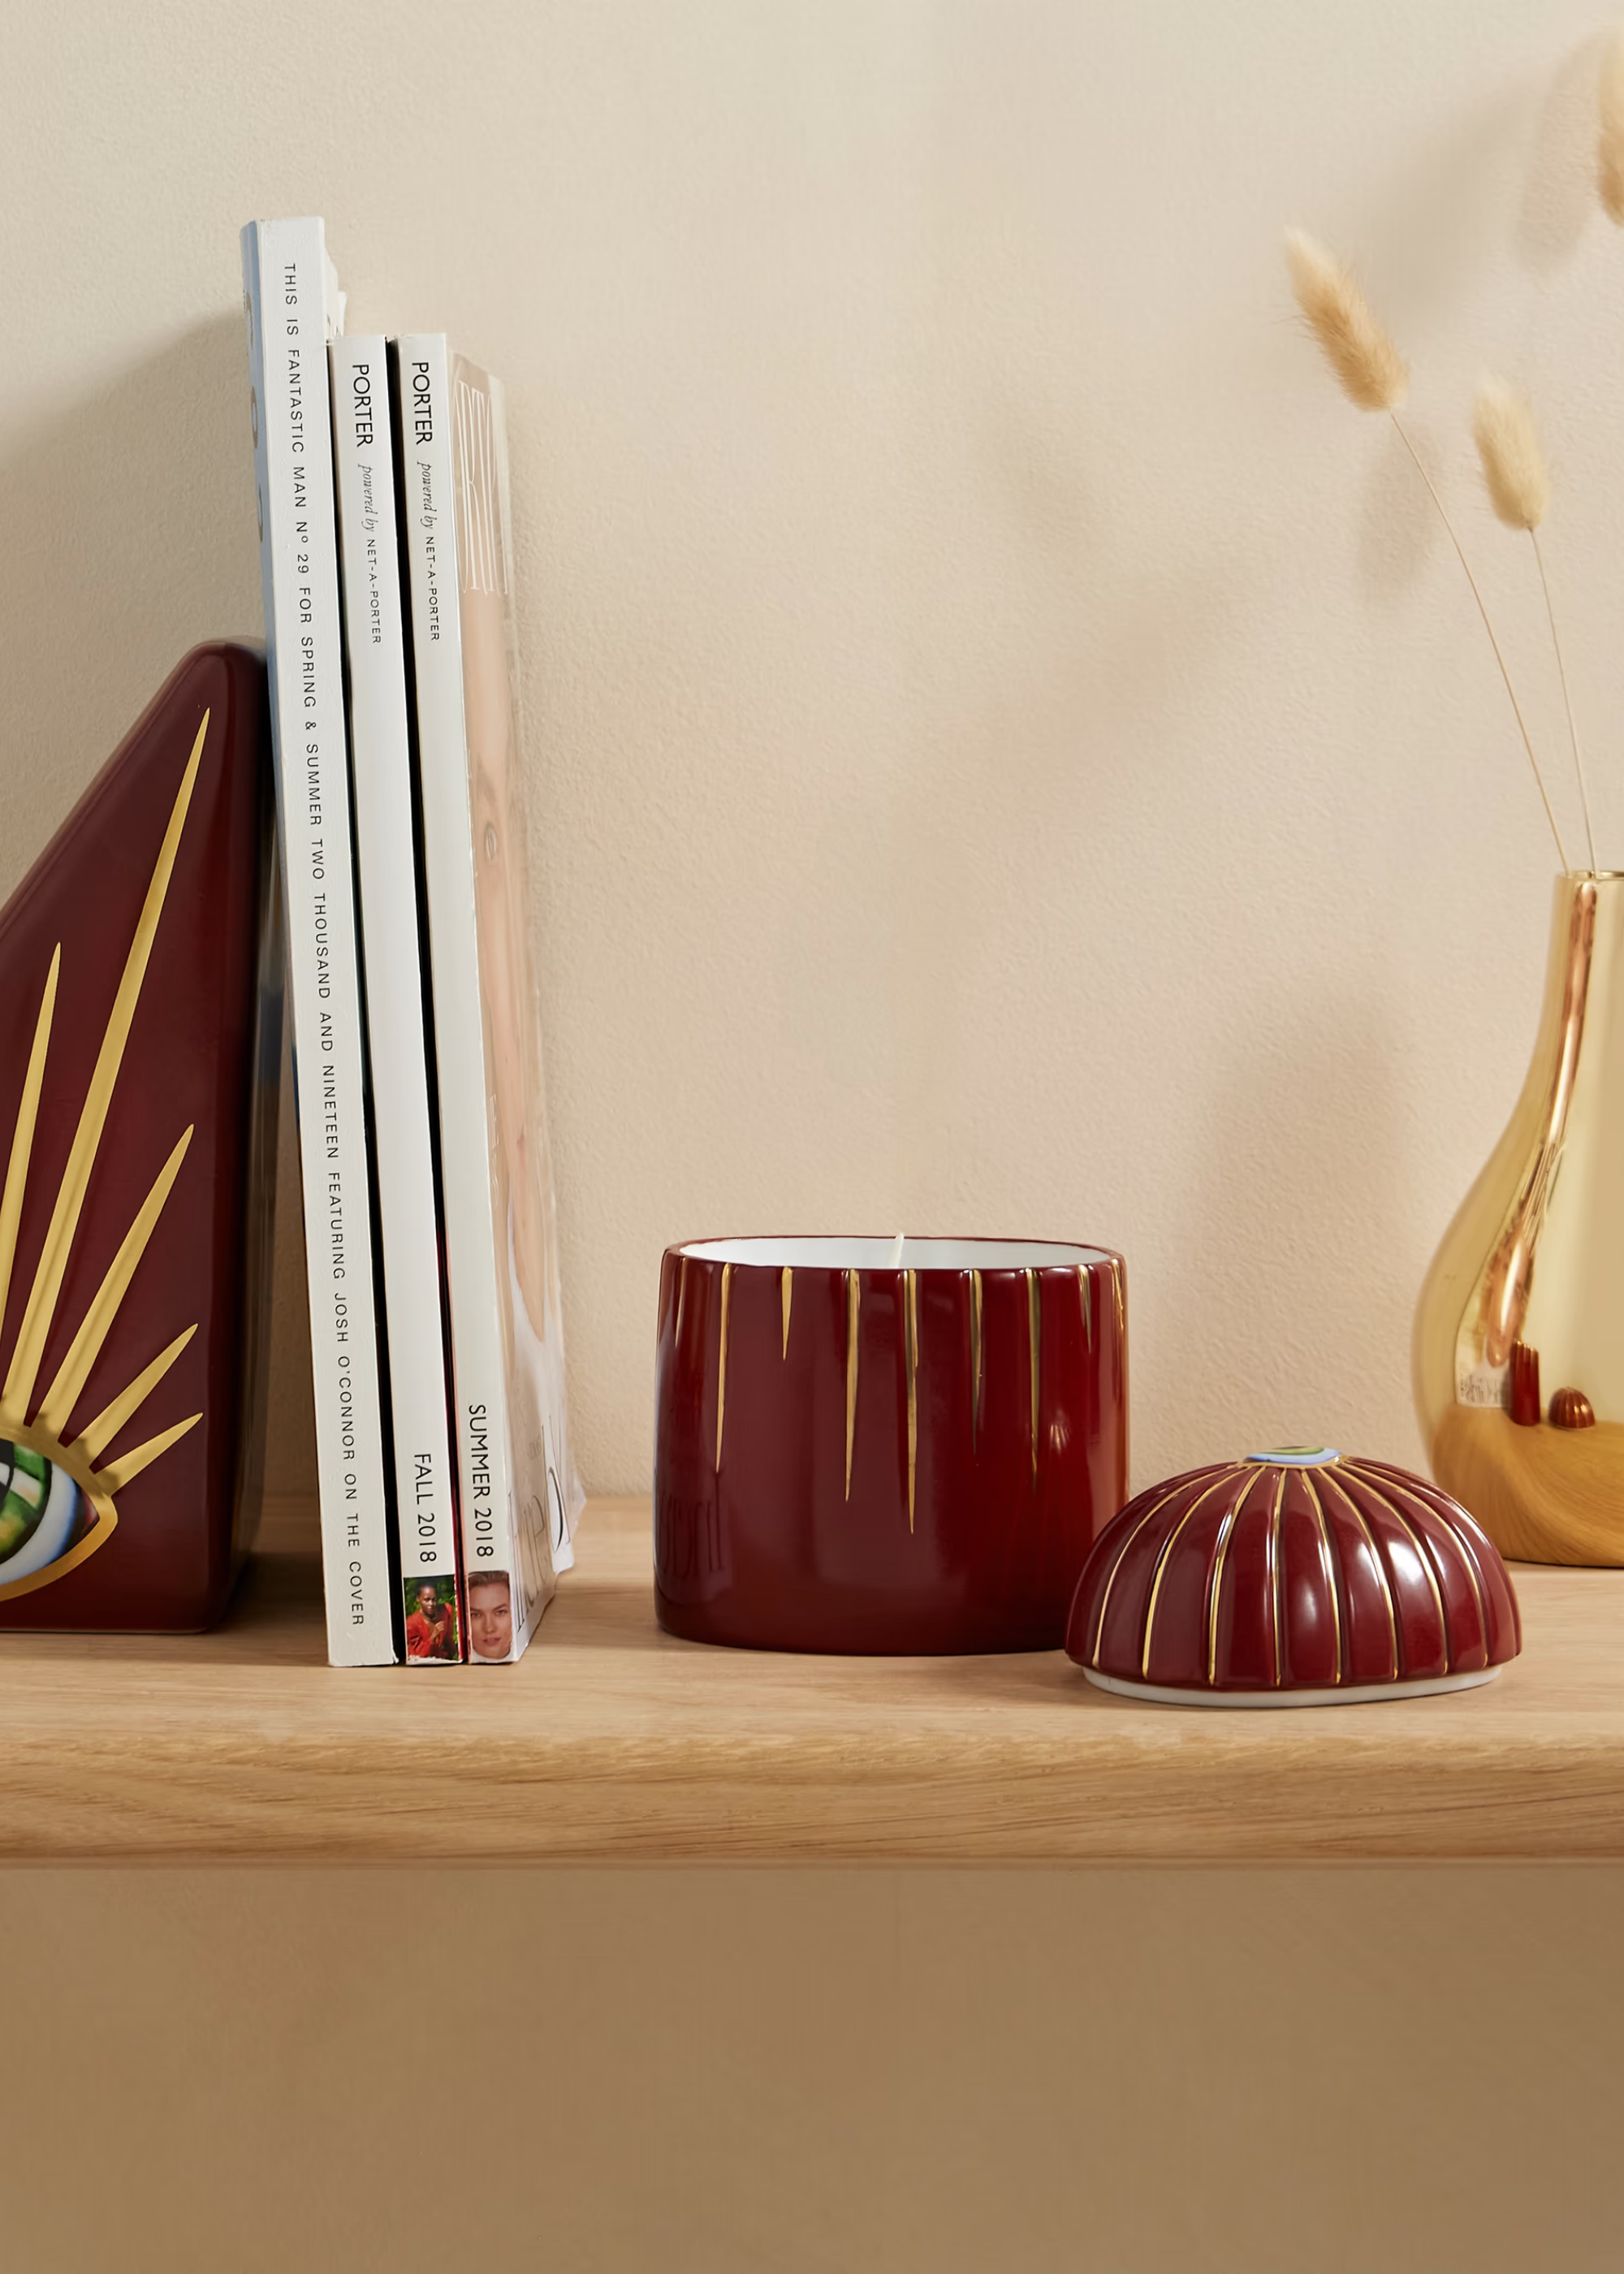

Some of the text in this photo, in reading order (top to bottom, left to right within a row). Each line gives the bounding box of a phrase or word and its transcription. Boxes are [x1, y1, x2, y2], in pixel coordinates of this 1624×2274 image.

[283, 262, 298, 305] THIS
[286, 318, 300, 336] IS
[287, 349, 304, 453] FANTASTIC
[292, 466, 307, 508] MAN
[352, 364, 382, 644] PORTER powered by NET-A-PORTER
[411, 361, 440, 642] PORTER powered by NET-A-PORTER
[297, 553, 309, 574] 29
[298, 586, 313, 624] FOR
[300, 636, 317, 708] SPRING
[304, 720, 317, 731] &
[305, 743, 322, 826] SUMMER
[310, 837, 326, 880] TWO
[313, 892, 330, 999] THOUSAND
[319, 1011, 334, 1052] AND
[322, 1065, 339, 1159] NINETEEN
[327, 1172, 346, 1280] FEATURING
[334, 1292, 349, 1342] JOSH
[343, 1472, 358, 1500] ON
[413, 1453, 438, 1564] FALL 2018
[468, 1403, 495, 1564] SUMMER 2018
[346, 1512, 361, 1548] THE
[348, 1561, 365, 1625] COVER
